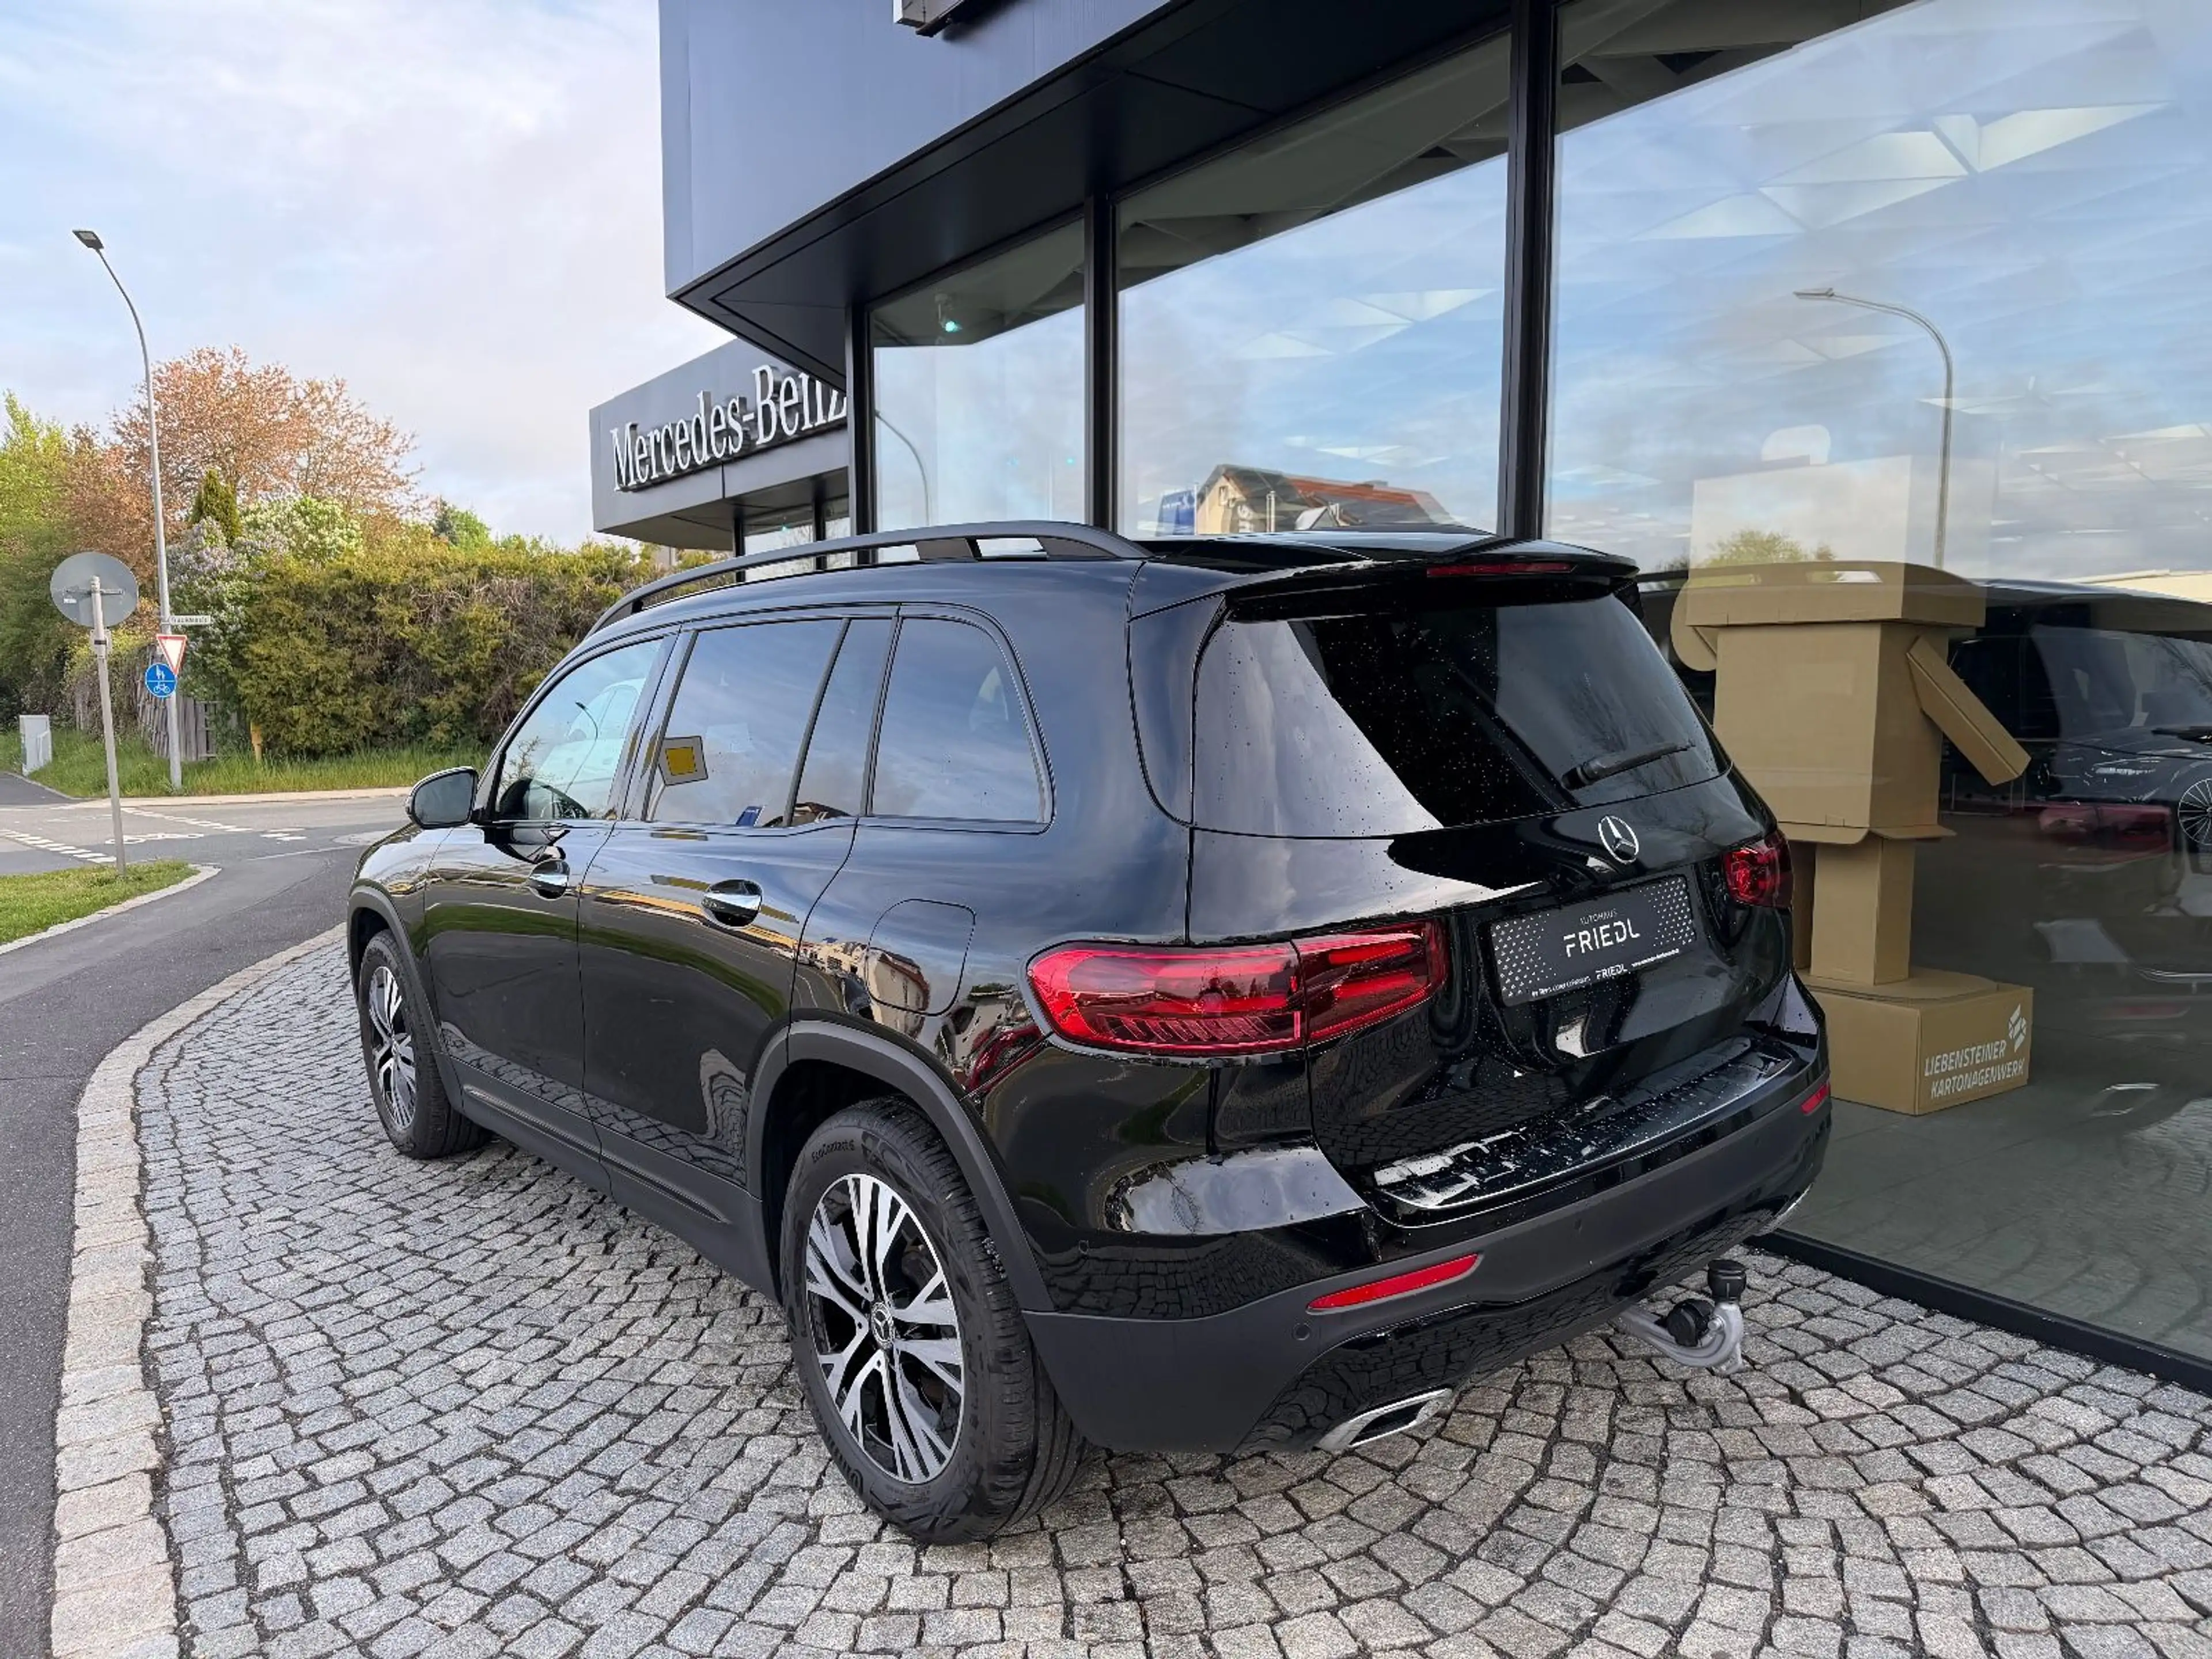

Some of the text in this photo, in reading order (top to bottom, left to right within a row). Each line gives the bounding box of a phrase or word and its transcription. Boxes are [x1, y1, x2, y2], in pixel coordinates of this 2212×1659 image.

[610, 365, 847, 491] Mercedes-Benz
[1563, 918, 1640, 957] FRIEDL
[1595, 964, 1628, 979] FRIEDL
[1925, 1040, 2007, 1076] LIEBENSTEINER
[1931, 1058, 2025, 1099] KARTONAGENWERK
